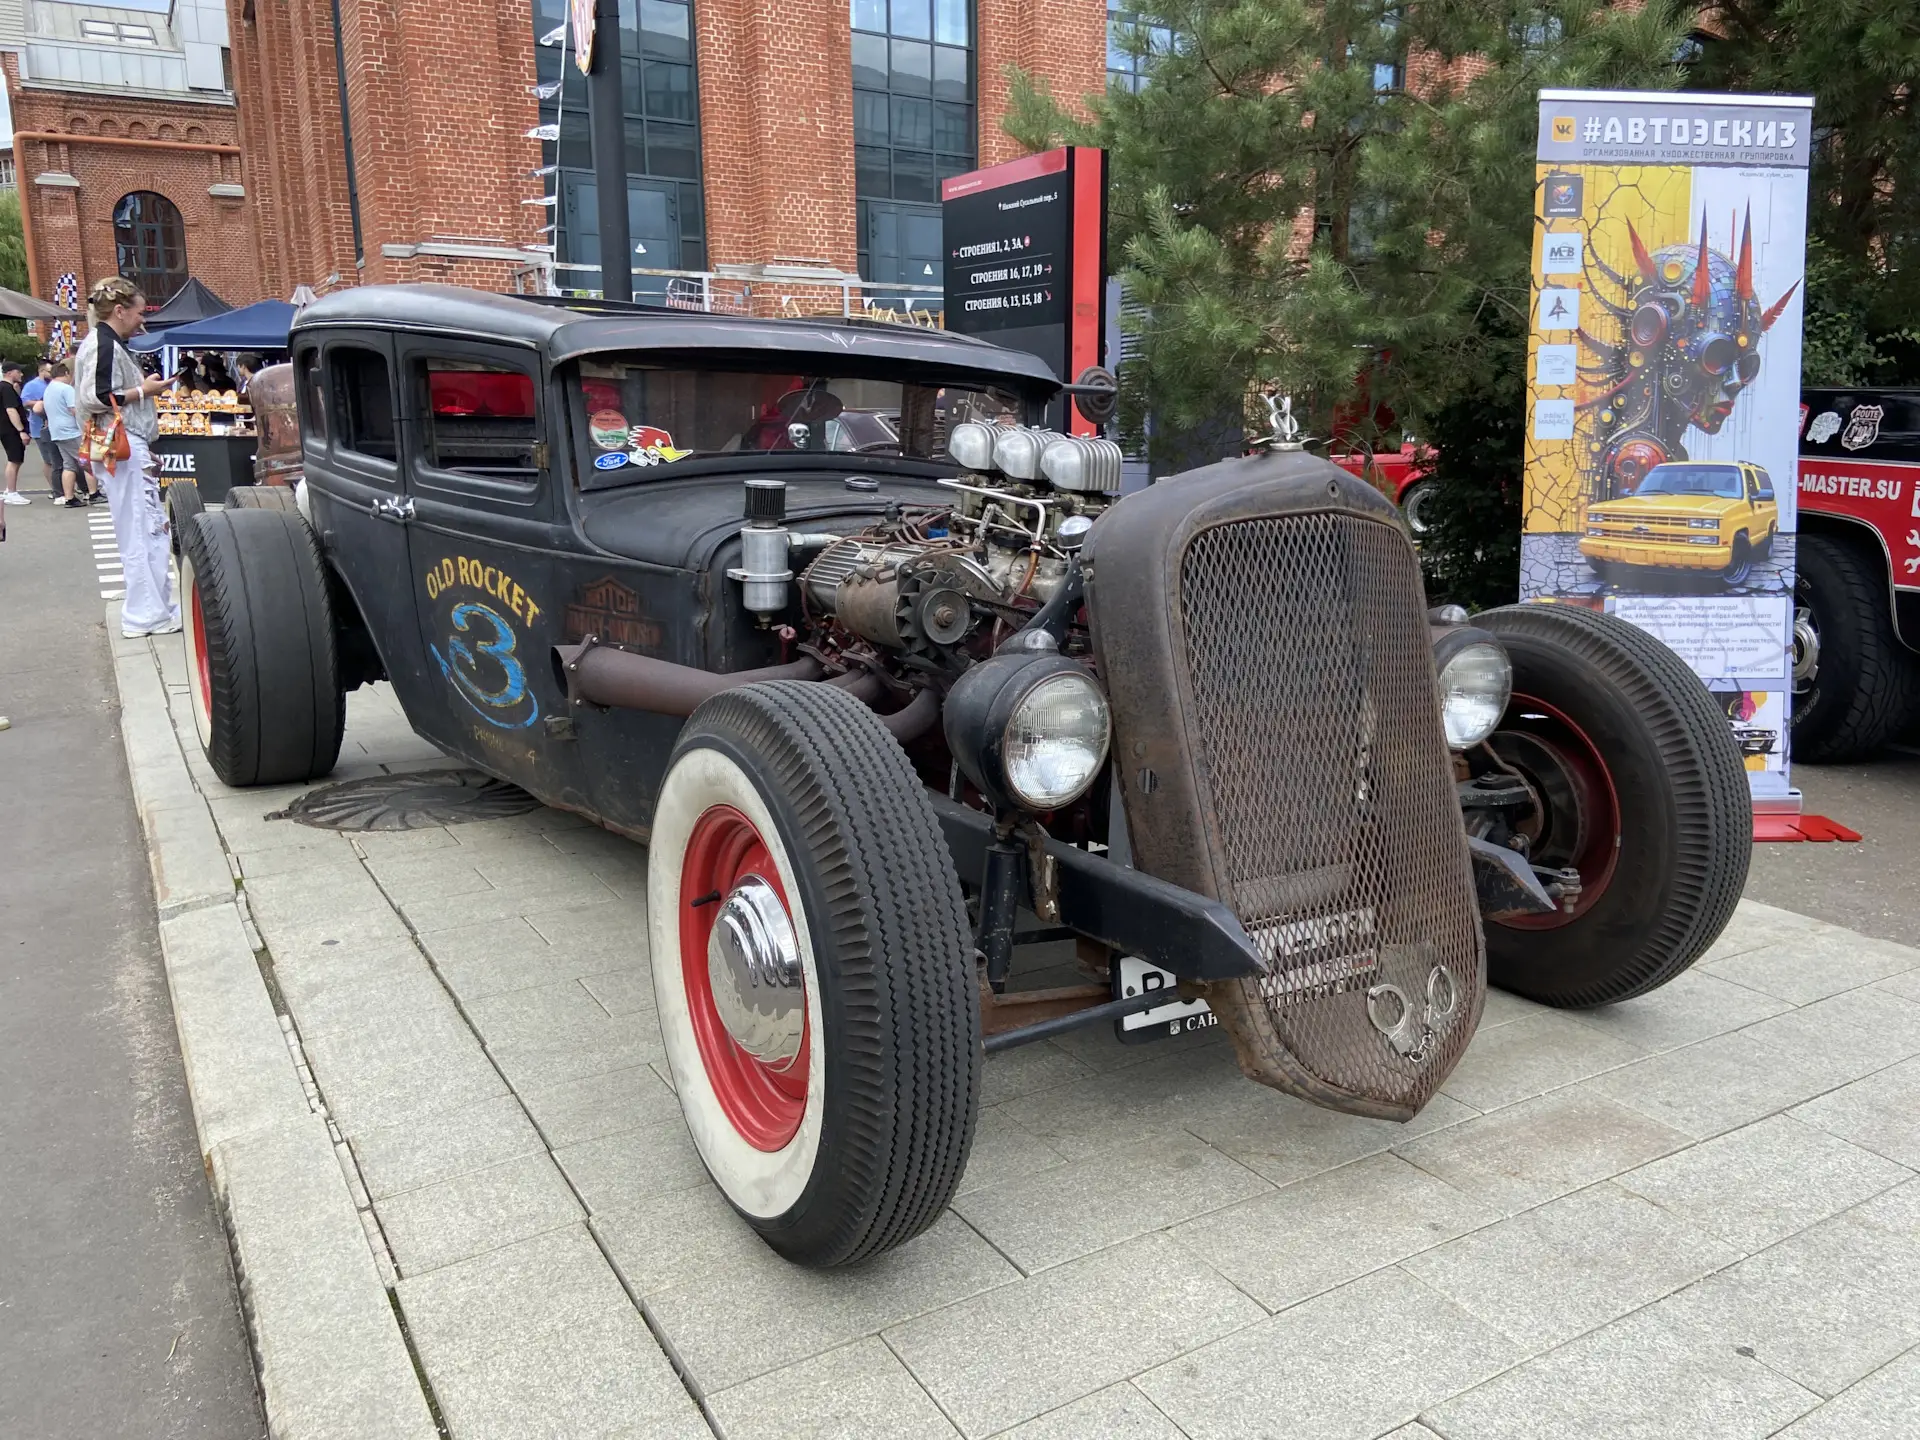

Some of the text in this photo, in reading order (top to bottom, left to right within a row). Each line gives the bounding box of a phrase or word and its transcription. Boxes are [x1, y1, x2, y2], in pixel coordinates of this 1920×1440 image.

[1583, 116, 1797, 149] #АВТОЭСКИЗ
[1583, 148, 1795, 161] ОРГАНИЗОВАННАЯ ХУДОЖЕСТВЕННАЯ ГРУППИРОВКА
[959, 242, 997, 258] СТРОЕНИЯ
[1003, 240, 1011, 252] 2,
[970, 264, 1043, 284] СТРОЕНИЯ 16, 17, 19
[964, 292, 1043, 311] СТРОЕНИЯ 6, 13, 15, 18
[1855, 408, 1880, 419] ROUTE
[426, 555, 540, 628] OLD ROCKET
[449, 601, 529, 708] 3
